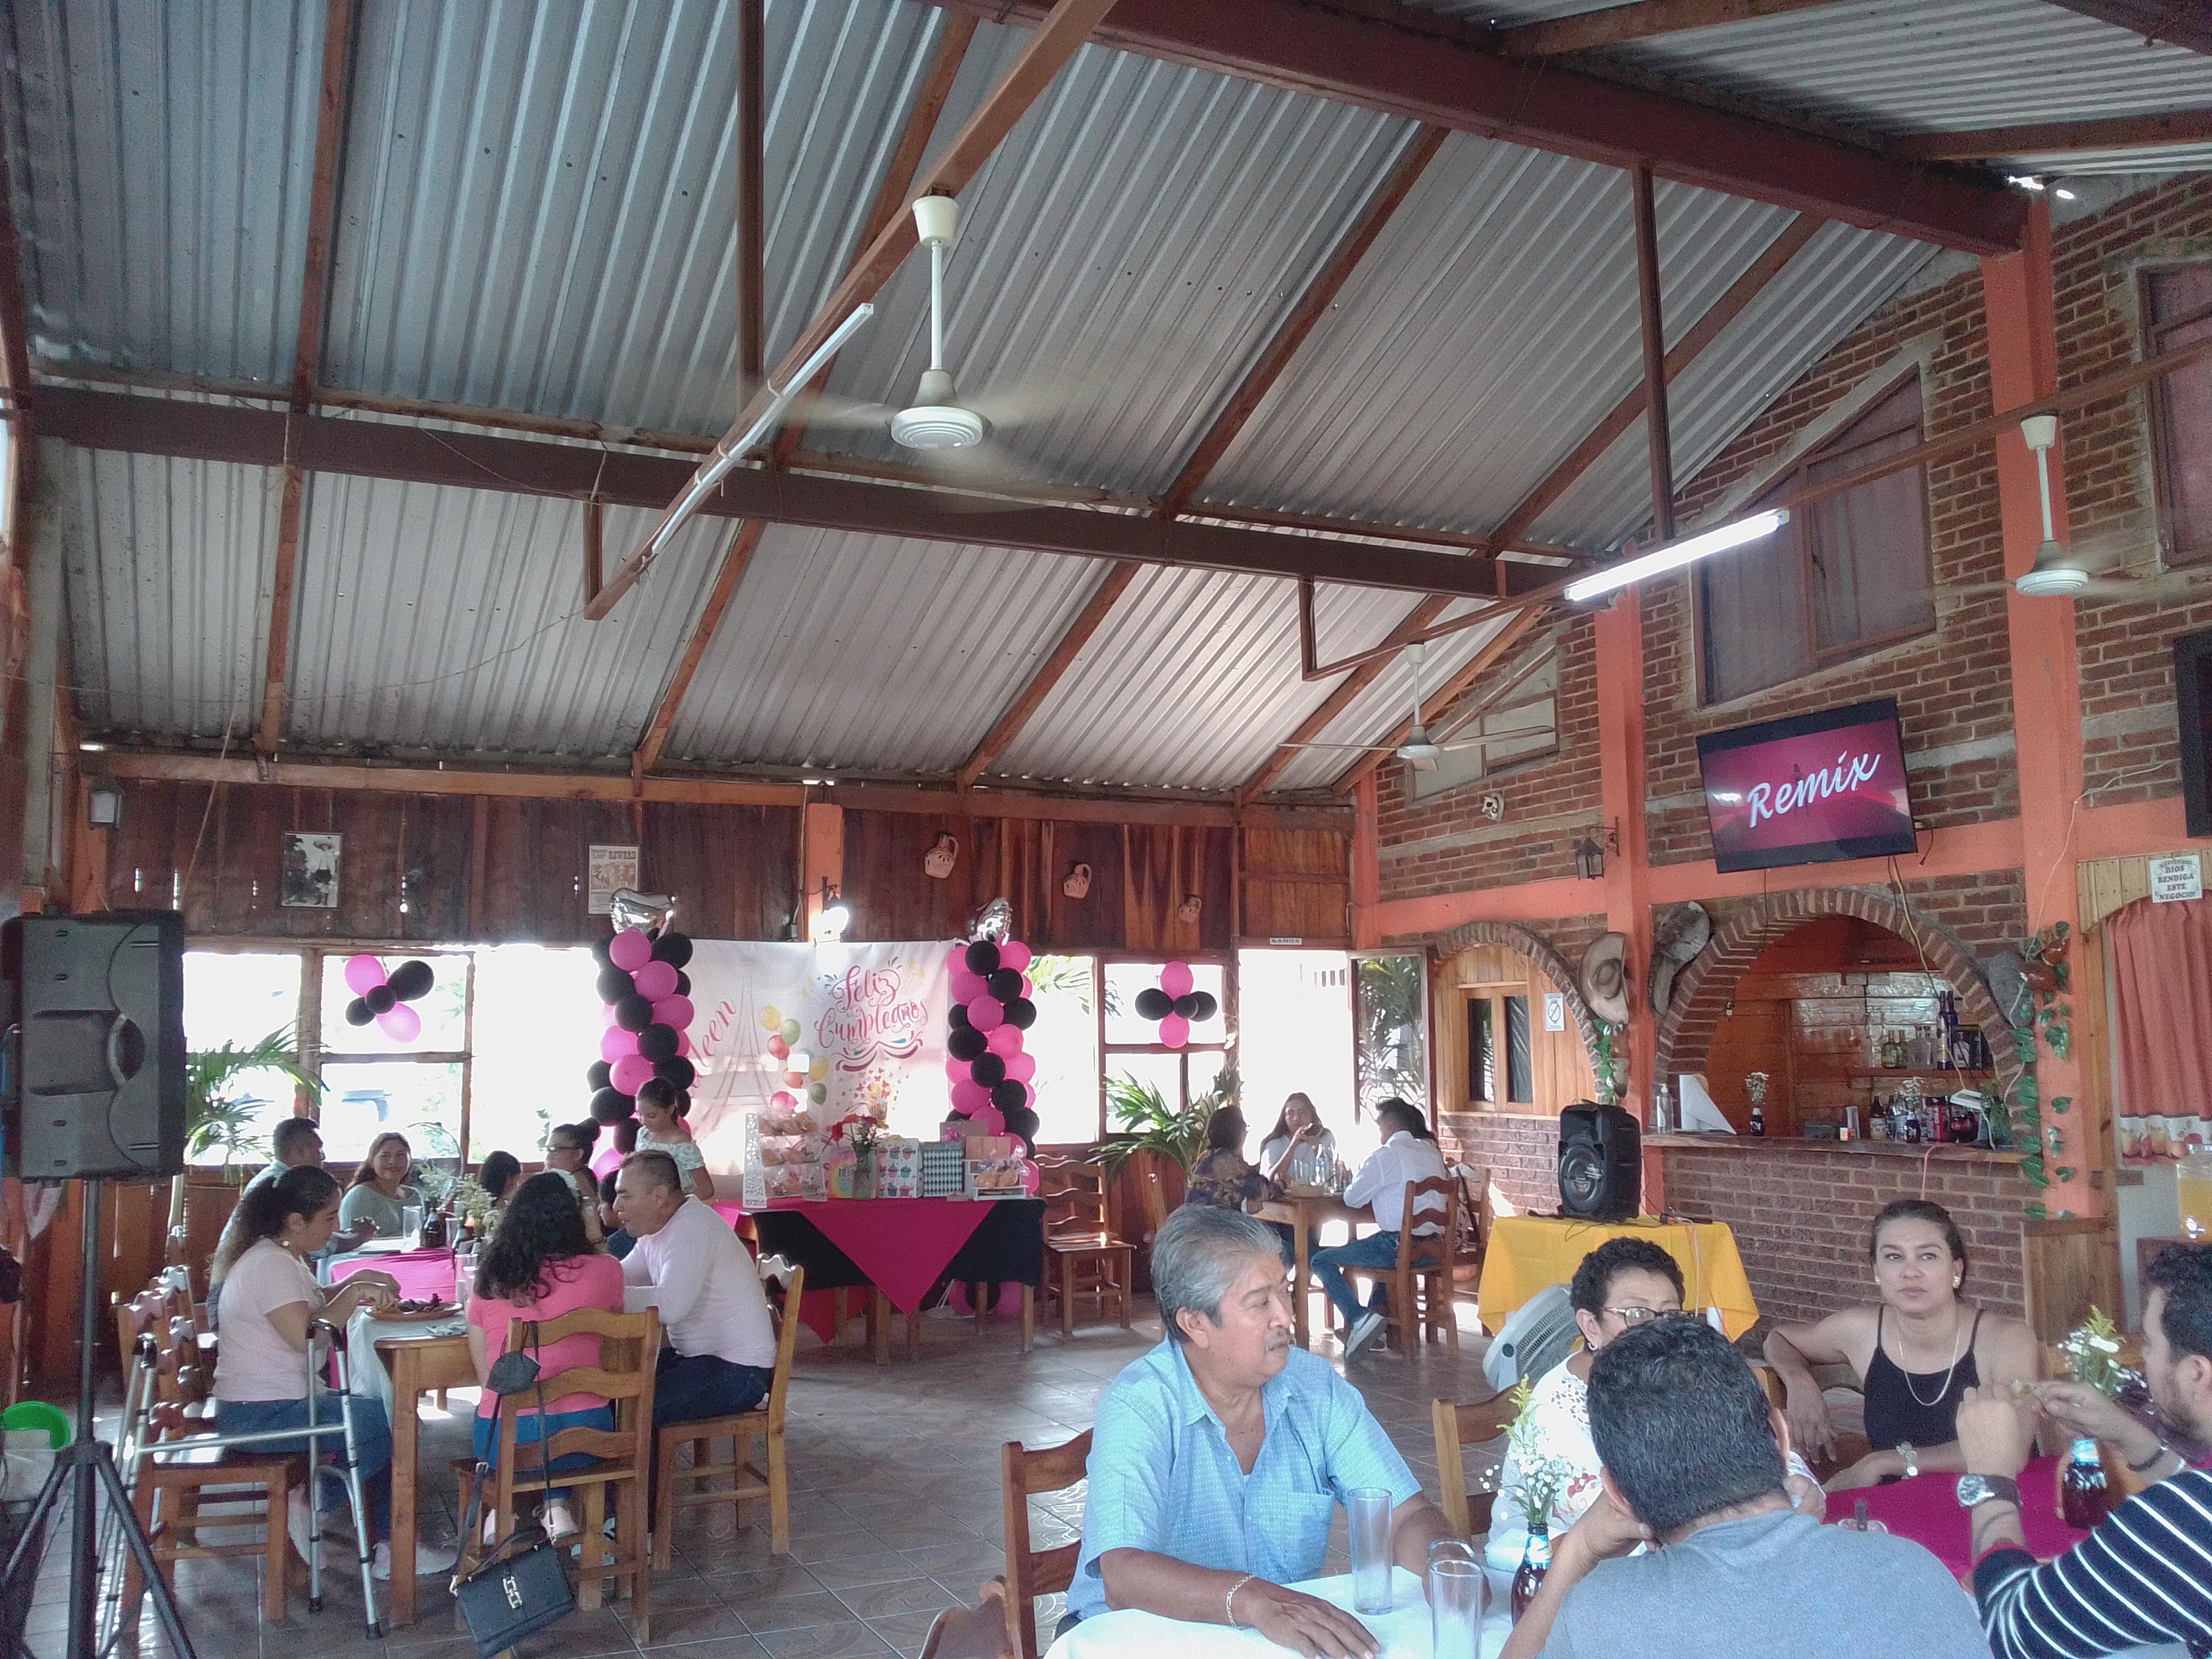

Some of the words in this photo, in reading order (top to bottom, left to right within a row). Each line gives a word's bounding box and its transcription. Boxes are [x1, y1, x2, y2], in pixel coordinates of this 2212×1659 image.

[1747, 750, 1881, 828] Remix
[2157, 873, 2194, 883] BENDIGA
[2165, 865, 2185, 873] DIOS
[832, 965, 901, 1012] Feliz
